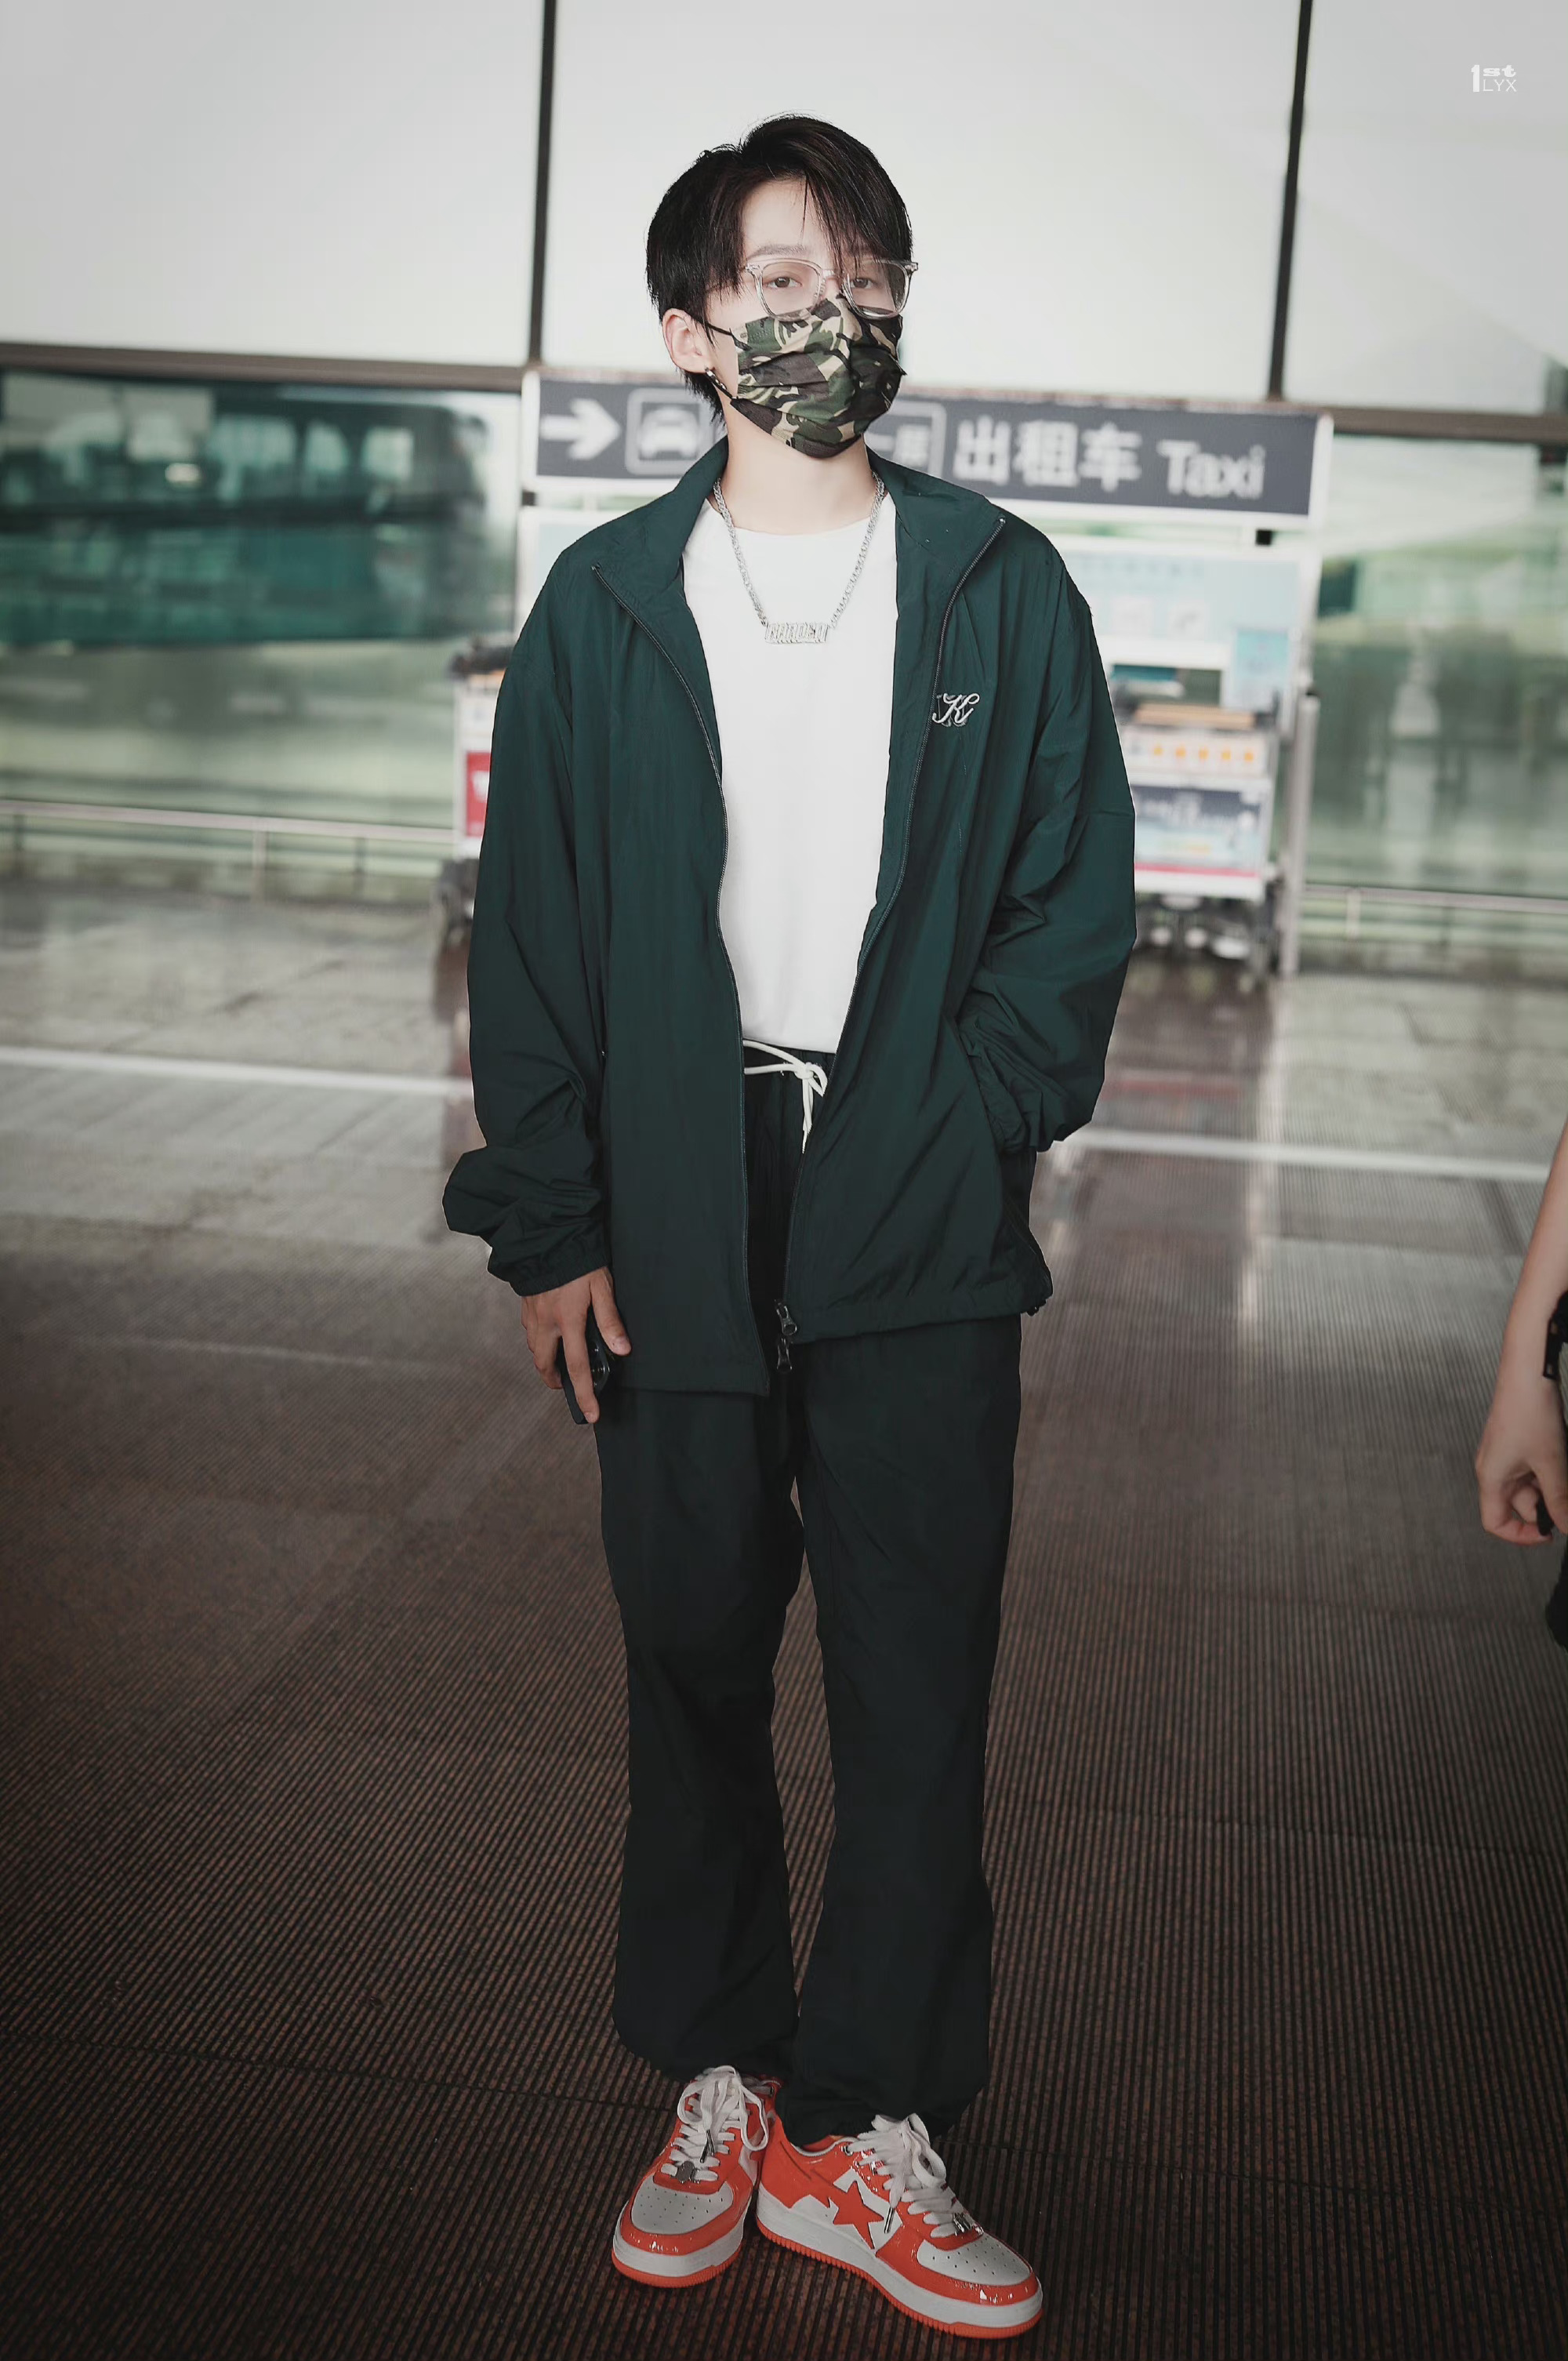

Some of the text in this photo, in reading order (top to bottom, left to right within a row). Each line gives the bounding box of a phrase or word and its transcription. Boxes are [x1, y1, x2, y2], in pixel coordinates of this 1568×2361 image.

[953, 416, 1266, 499] 出租车 Taxi
